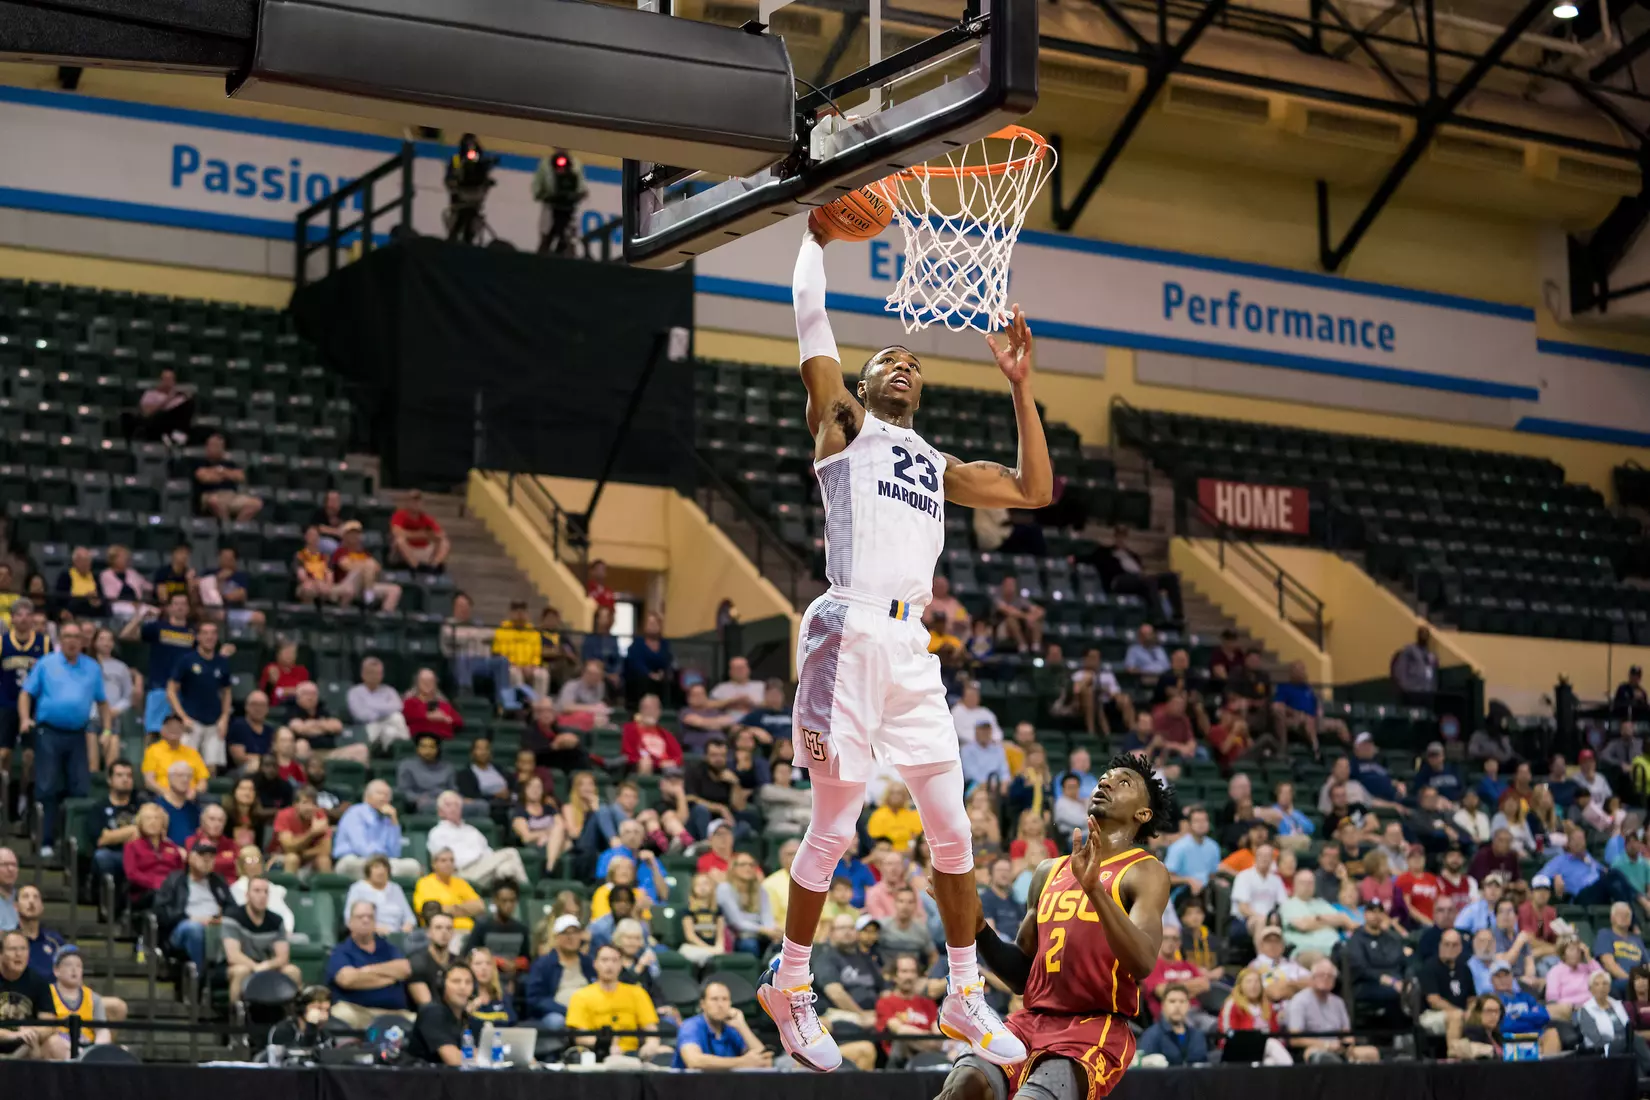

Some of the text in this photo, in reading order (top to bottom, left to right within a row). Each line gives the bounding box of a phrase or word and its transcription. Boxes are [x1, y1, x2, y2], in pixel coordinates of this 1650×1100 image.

[1163, 282, 1396, 352] Performance
[892, 445, 938, 493] 23
[1216, 483, 1292, 529] HOME
[1045, 927, 1066, 973] 2
